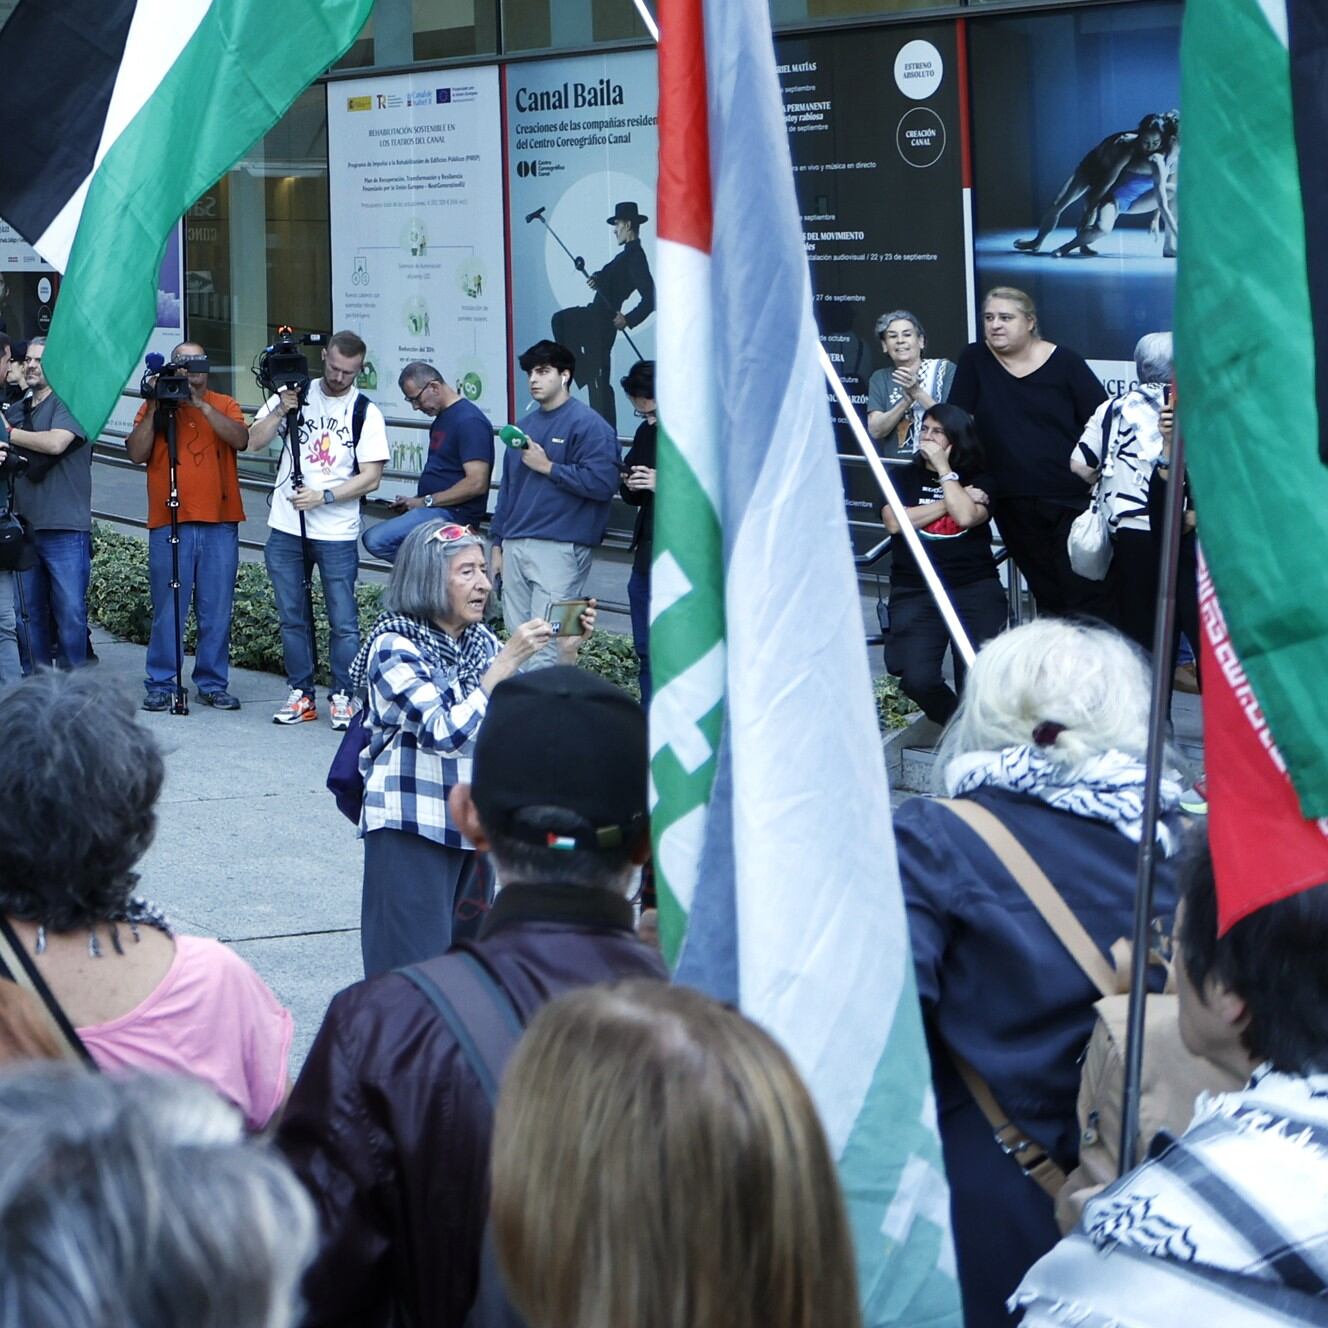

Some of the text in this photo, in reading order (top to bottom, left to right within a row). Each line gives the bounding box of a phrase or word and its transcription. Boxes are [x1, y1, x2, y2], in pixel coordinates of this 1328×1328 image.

[792, 62, 817, 72] MATÍAS
[904, 62, 932, 70] ESTRENO
[903, 70, 934, 79] ABSOLUTO
[516, 79, 624, 112] Canal Baila
[788, 102, 831, 112] PERMANENTE
[799, 113, 823, 121] rabiosa
[369, 123, 455, 137] REHABILITACIÓN SOSTENIBLE EN
[516, 117, 626, 134] Creaciones de las compañías
[906, 128, 936, 138] CREACIÓN
[392, 137, 414, 147] TEATROS
[415, 137, 425, 145] DEL
[427, 136, 445, 144] CANAL
[516, 132, 631, 149] del Centro Coreográfico Canal
[807, 232, 864, 240] DEL MOVIMIENTO
[903, 253, 937, 261] septiembre
